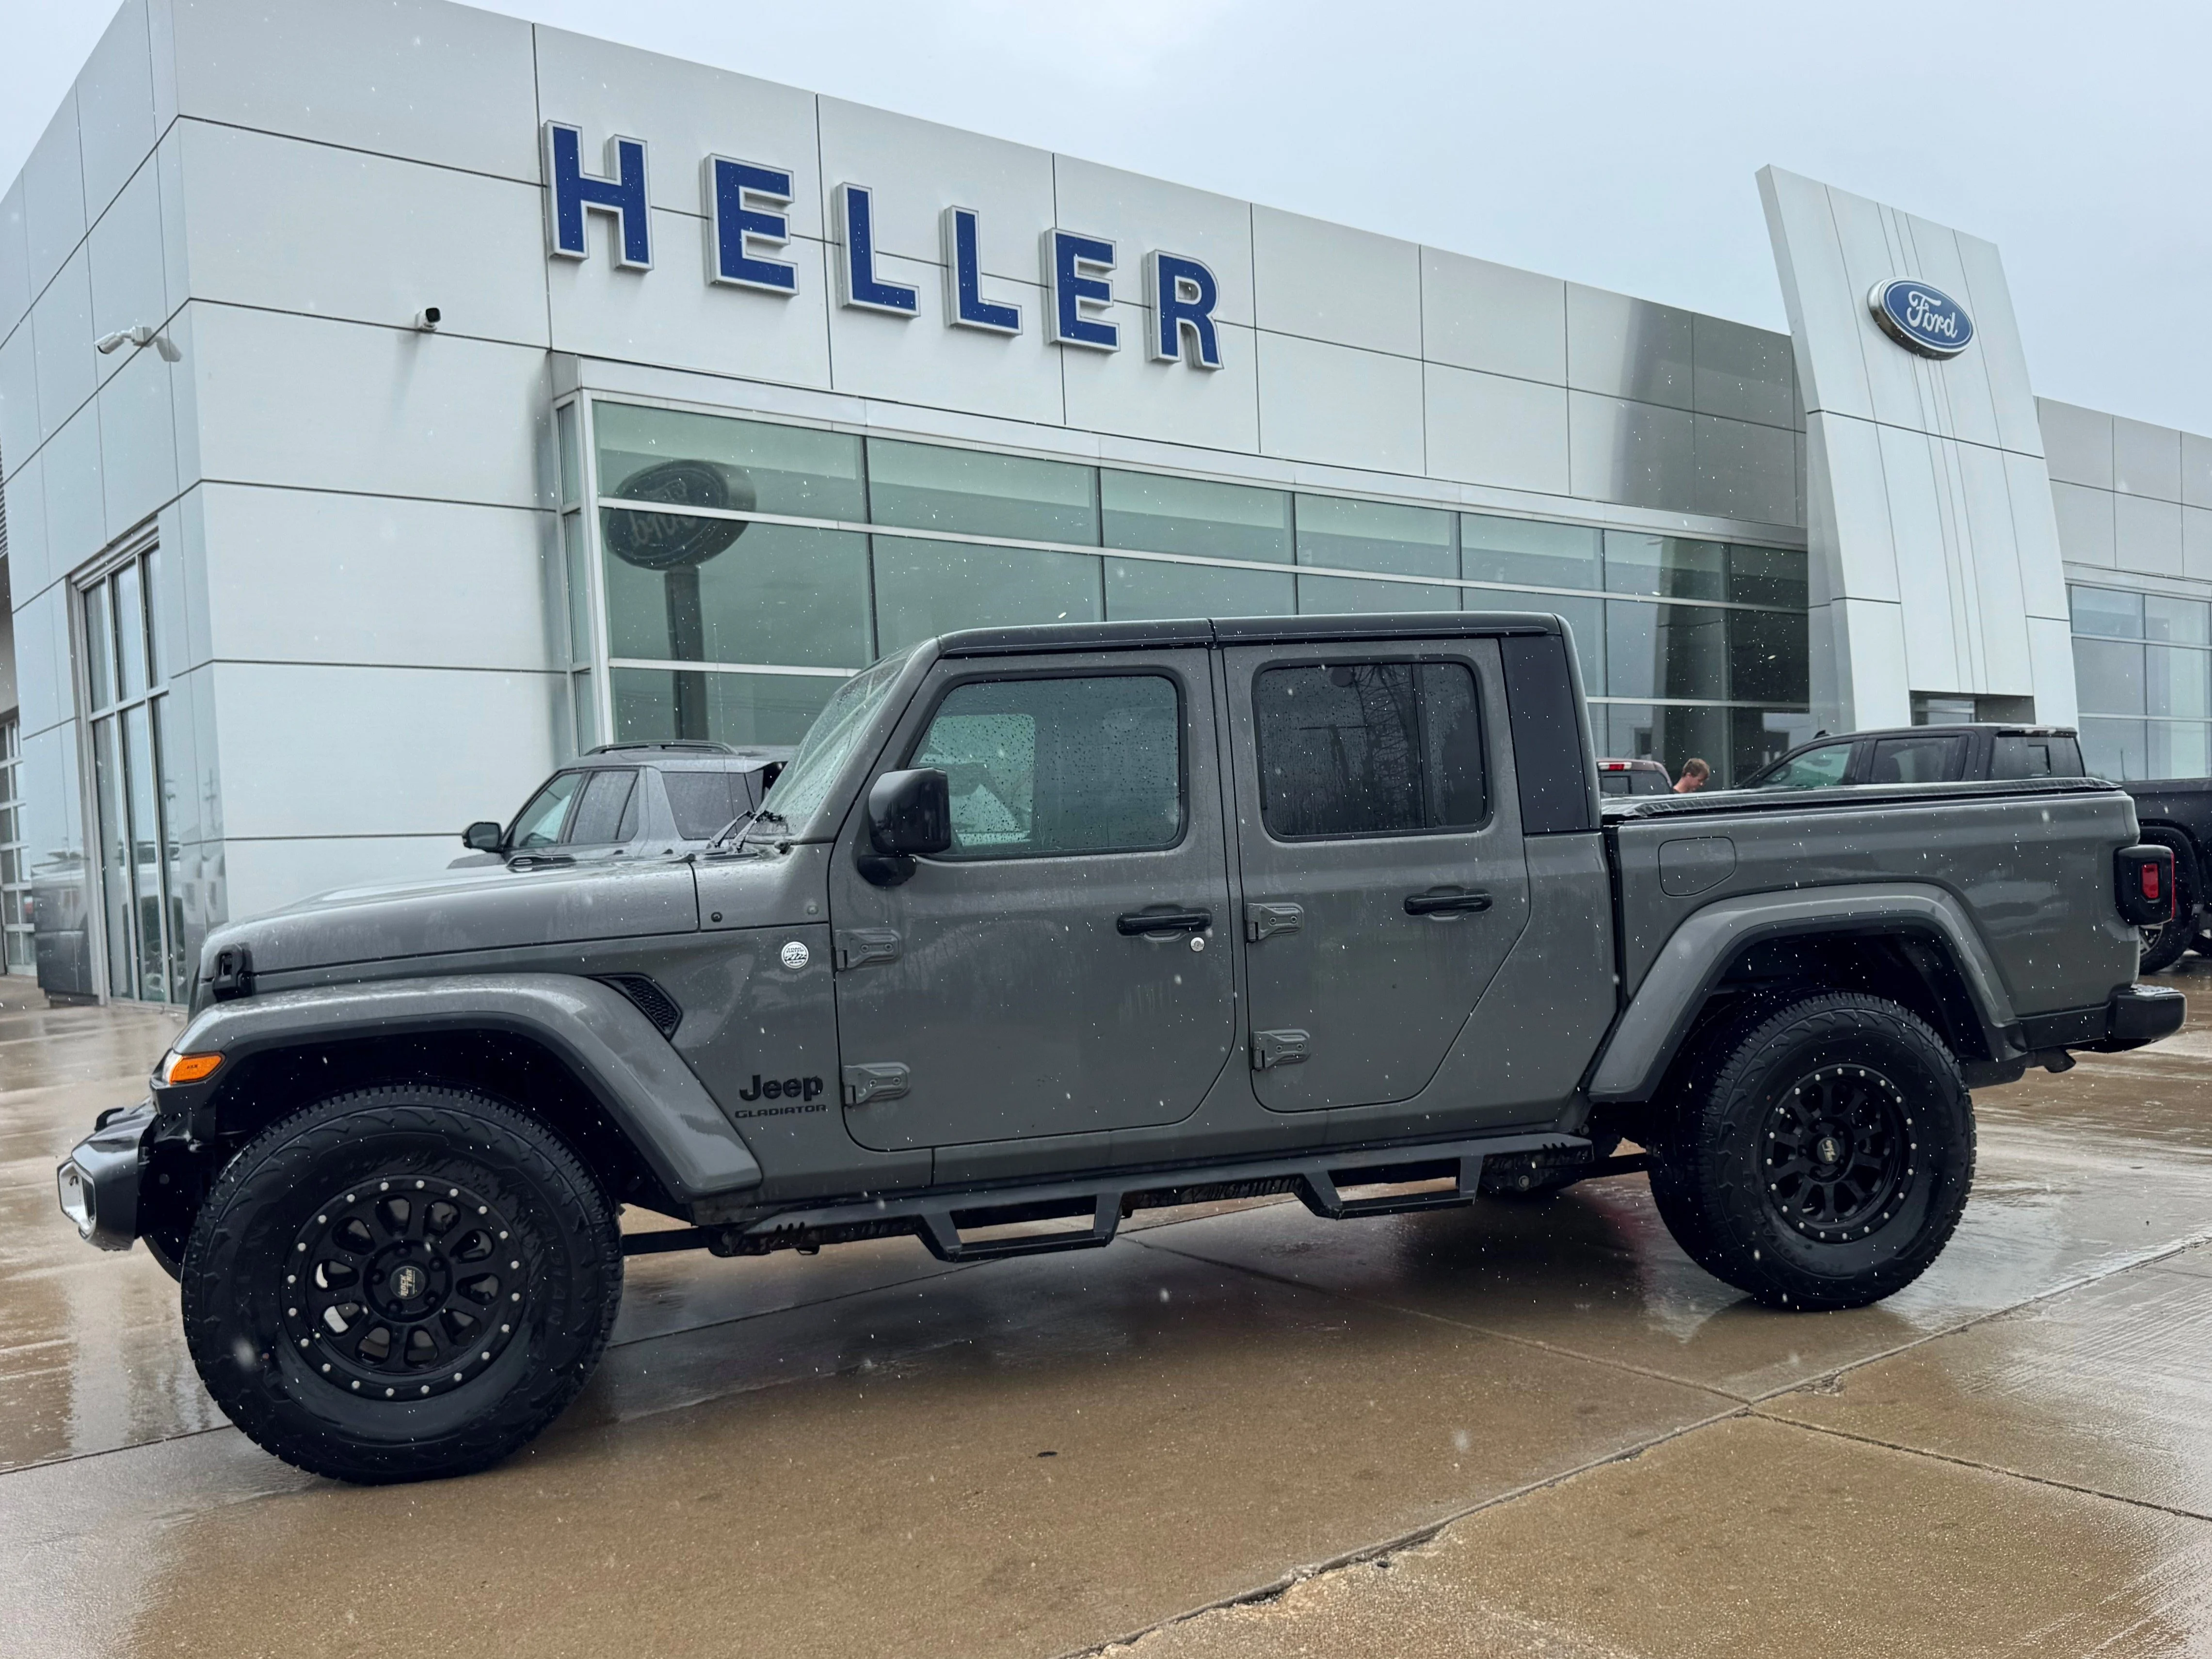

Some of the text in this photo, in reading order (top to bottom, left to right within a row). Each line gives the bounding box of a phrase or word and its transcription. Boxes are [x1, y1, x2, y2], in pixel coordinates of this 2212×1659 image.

[544, 120, 1224, 370] HELLER
[1907, 290, 1958, 338] Ford
[739, 1074, 823, 1101] Jeep
[735, 1104, 827, 1118] GLADIATOR
